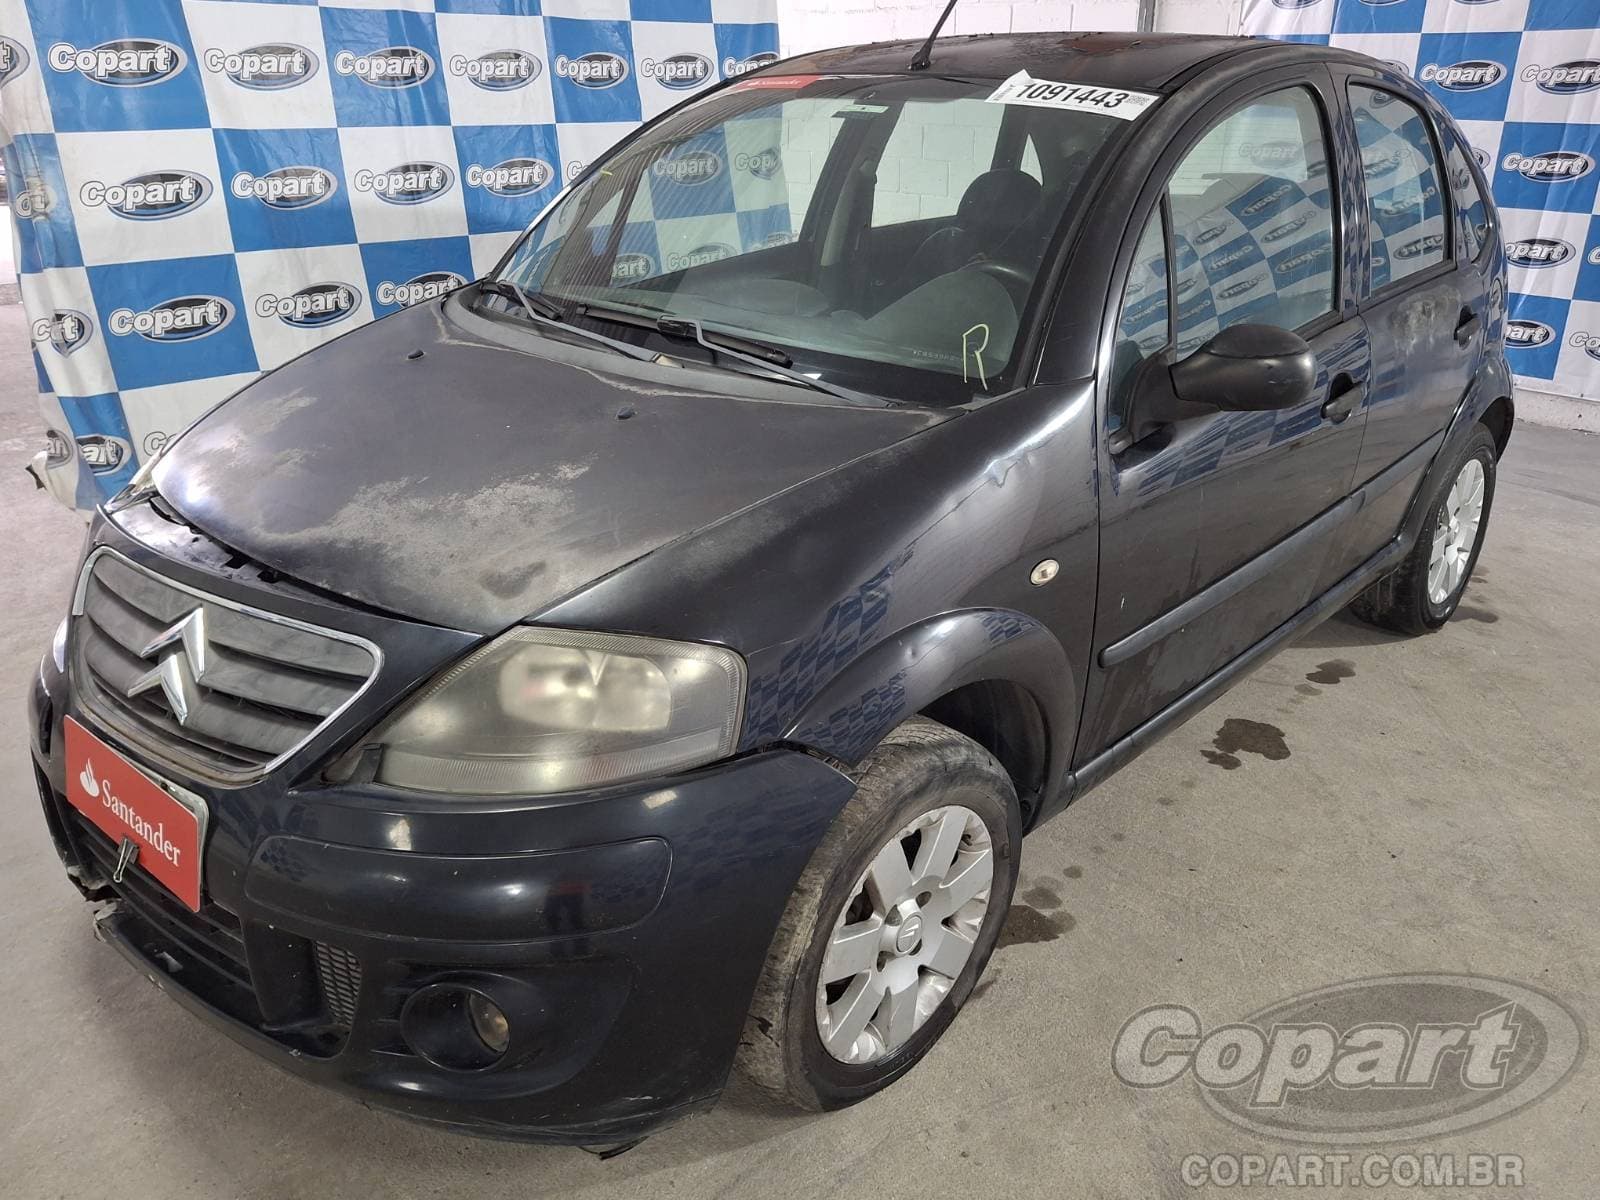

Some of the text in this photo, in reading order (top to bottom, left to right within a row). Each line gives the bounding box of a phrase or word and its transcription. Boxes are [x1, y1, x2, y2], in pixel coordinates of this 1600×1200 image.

[49, 42, 172, 77] Copart
[204, 47, 306, 78] Copart
[334, 50, 425, 81] Copart
[448, 50, 530, 82] Copart
[555, 53, 622, 80] Copart
[640, 53, 706, 80] Copart
[1420, 64, 1497, 85] Copart
[1016, 83, 1130, 109] 1091443
[354, 164, 444, 194] Copart
[466, 157, 546, 191] Copart
[654, 155, 716, 179] Copart
[1502, 152, 1586, 177] Copart
[80, 178, 198, 211] Copart
[232, 170, 327, 200] Copart
[1505, 242, 1566, 260] opart
[255, 286, 352, 322] Copart
[376, 273, 459, 307] Copart
[108, 299, 223, 337] Copart
[962, 323, 990, 391] R
[102, 779, 181, 867] Santander
